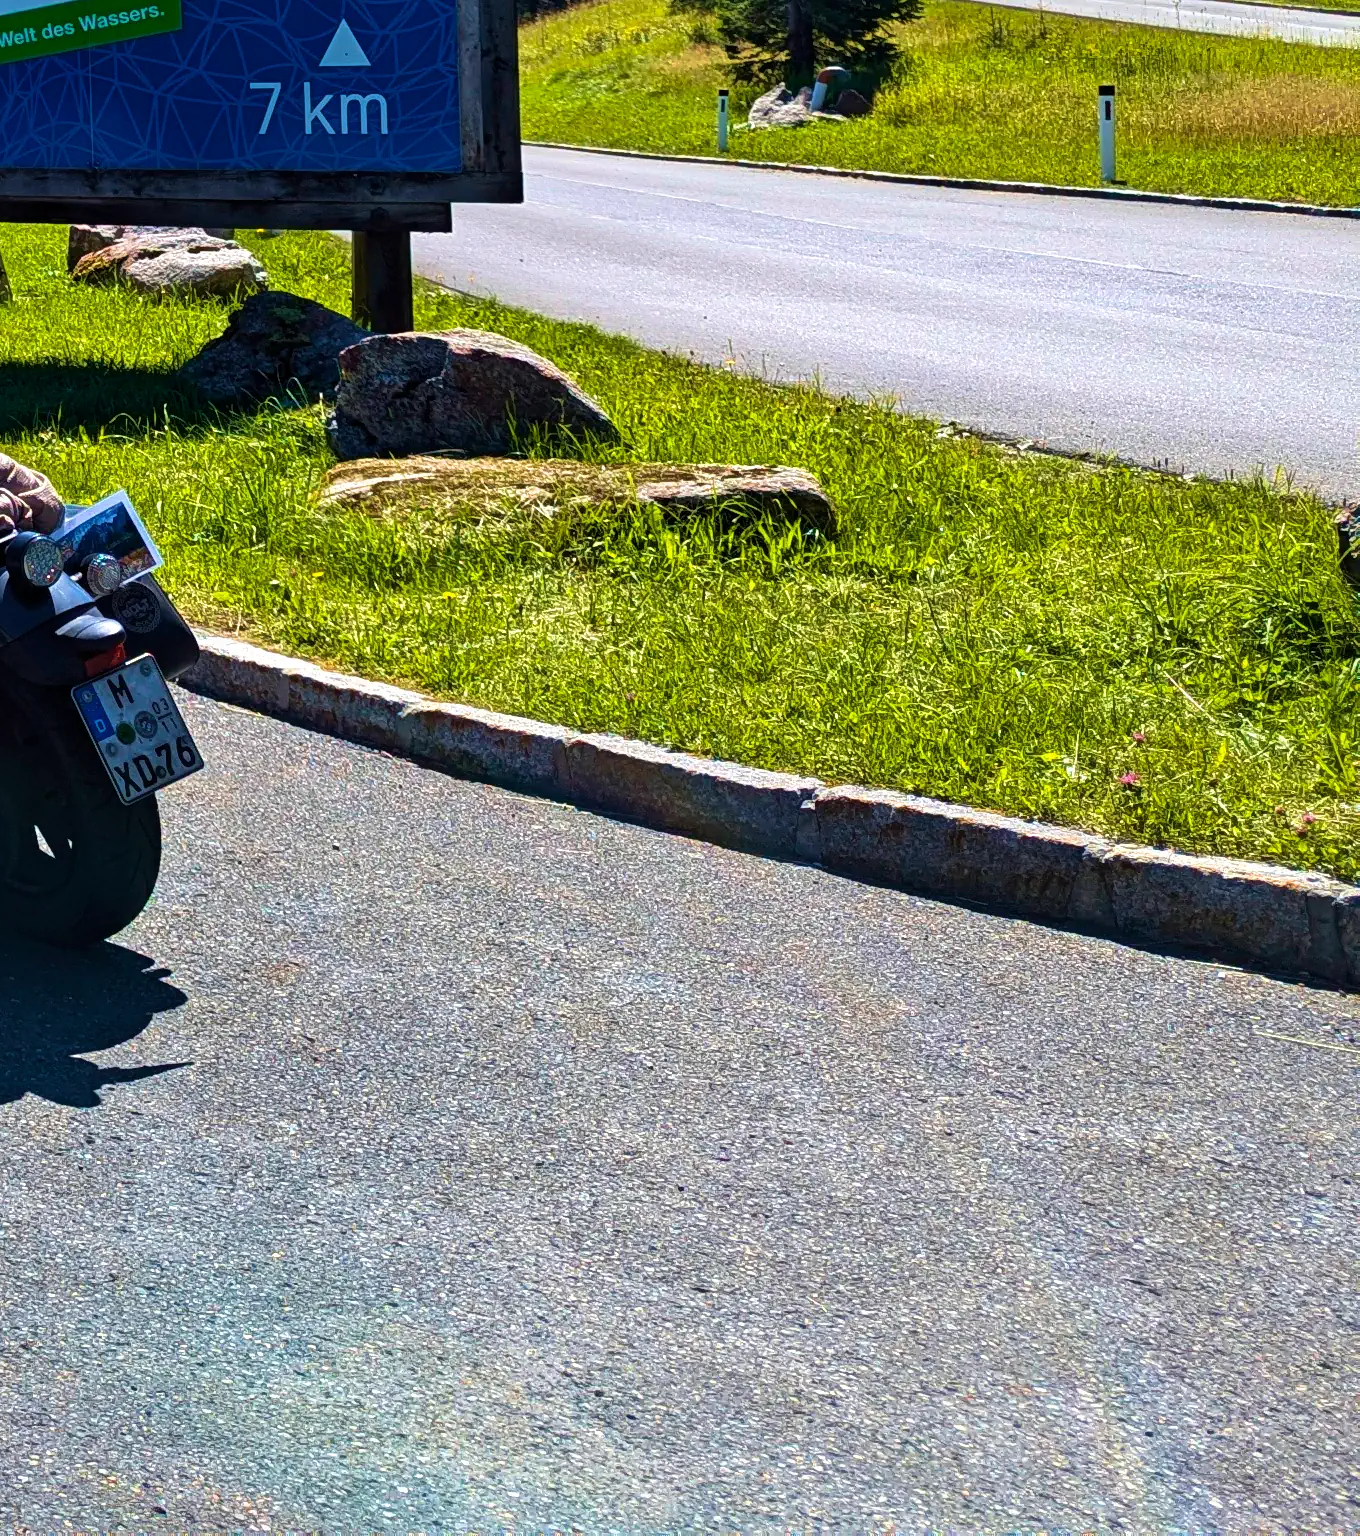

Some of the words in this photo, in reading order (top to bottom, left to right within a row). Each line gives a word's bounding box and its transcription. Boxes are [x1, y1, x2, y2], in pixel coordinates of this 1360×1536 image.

[41, 20, 76, 40] des
[78, 5, 166, 31] Wassers.
[249, 82, 281, 135] 7
[304, 82, 389, 135] km
[106, 674, 134, 709] M
[151, 697, 170, 715] 03
[93, 718, 107, 734] D
[161, 717, 178, 733] 11
[114, 754, 158, 798] XD
[154, 736, 196, 777] 76
